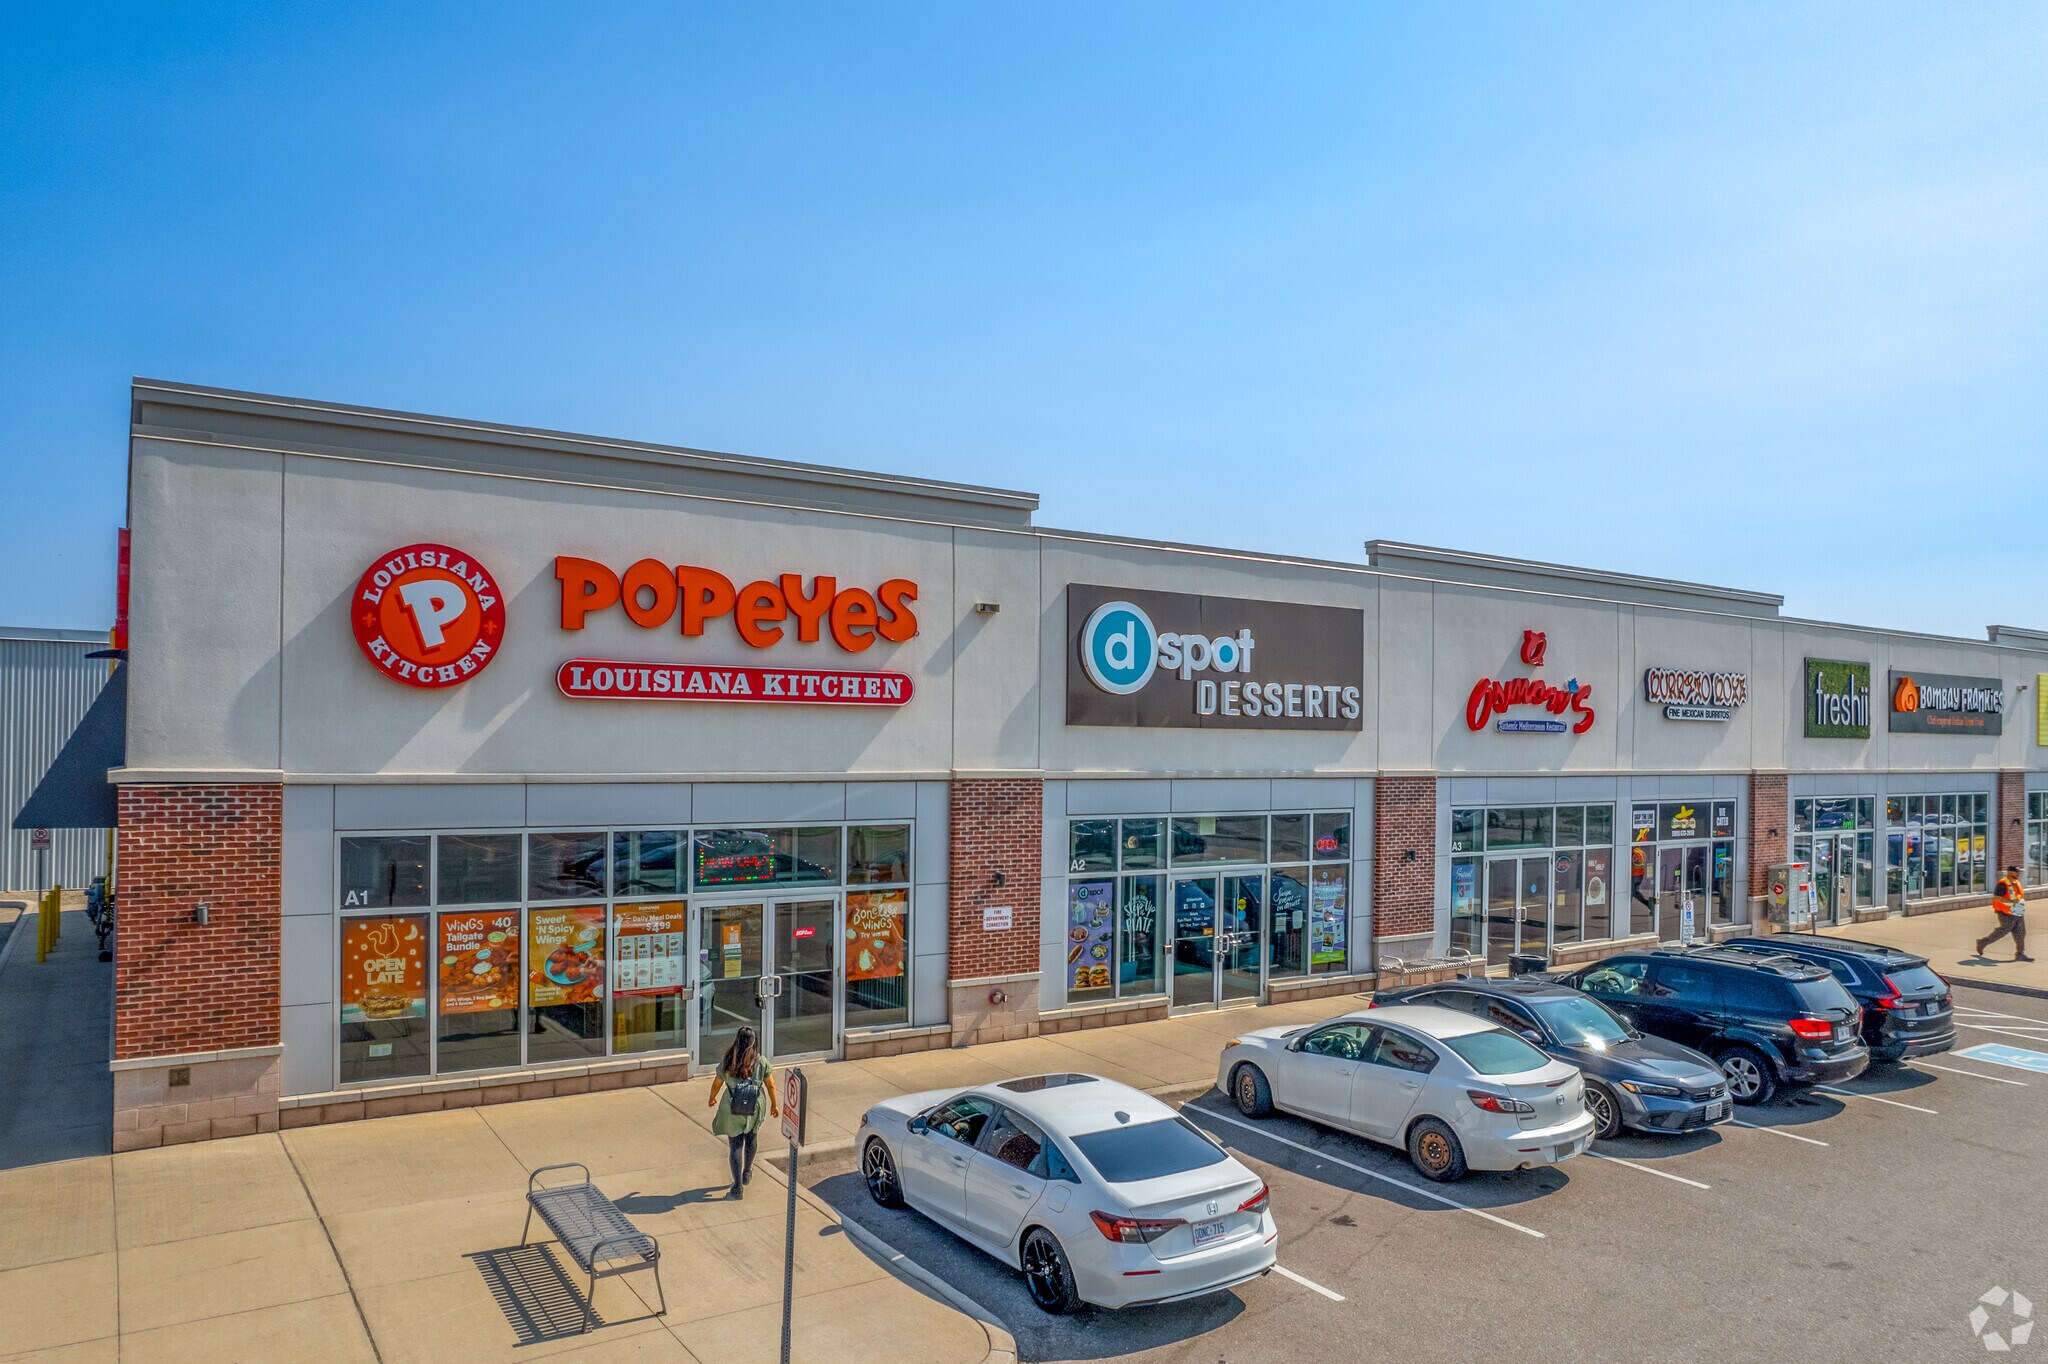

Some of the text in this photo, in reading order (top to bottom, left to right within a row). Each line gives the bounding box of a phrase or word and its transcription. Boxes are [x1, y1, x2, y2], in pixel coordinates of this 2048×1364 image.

[363, 550, 496, 612] LOUISIANA
[399, 579, 467, 649] P
[367, 636, 492, 683] KITCHEN
[1156, 628, 1255, 681] spot
[570, 667, 904, 698] LOUISIANA KITCHEN
[1196, 679, 1361, 719] DESSERTS
[1816, 671, 1869, 726] freshii
[1668, 708, 1730, 720] FINE MEXICAN BURRITOS
[1316, 838, 1338, 850] OPEN
[1452, 841, 1462, 851] A3
[1071, 859, 1086, 871] A2
[344, 890, 368, 906] A1
[535, 915, 567, 925] Sweet
[548, 924, 575, 935] Spicy
[446, 932, 484, 942] Tailgate
[535, 935, 567, 945] Wings
[446, 942, 480, 951] Bundle
[363, 958, 406, 972] OPEN
[367, 971, 405, 985] LATE
[1212, 1222, 1225, 1235] 715
